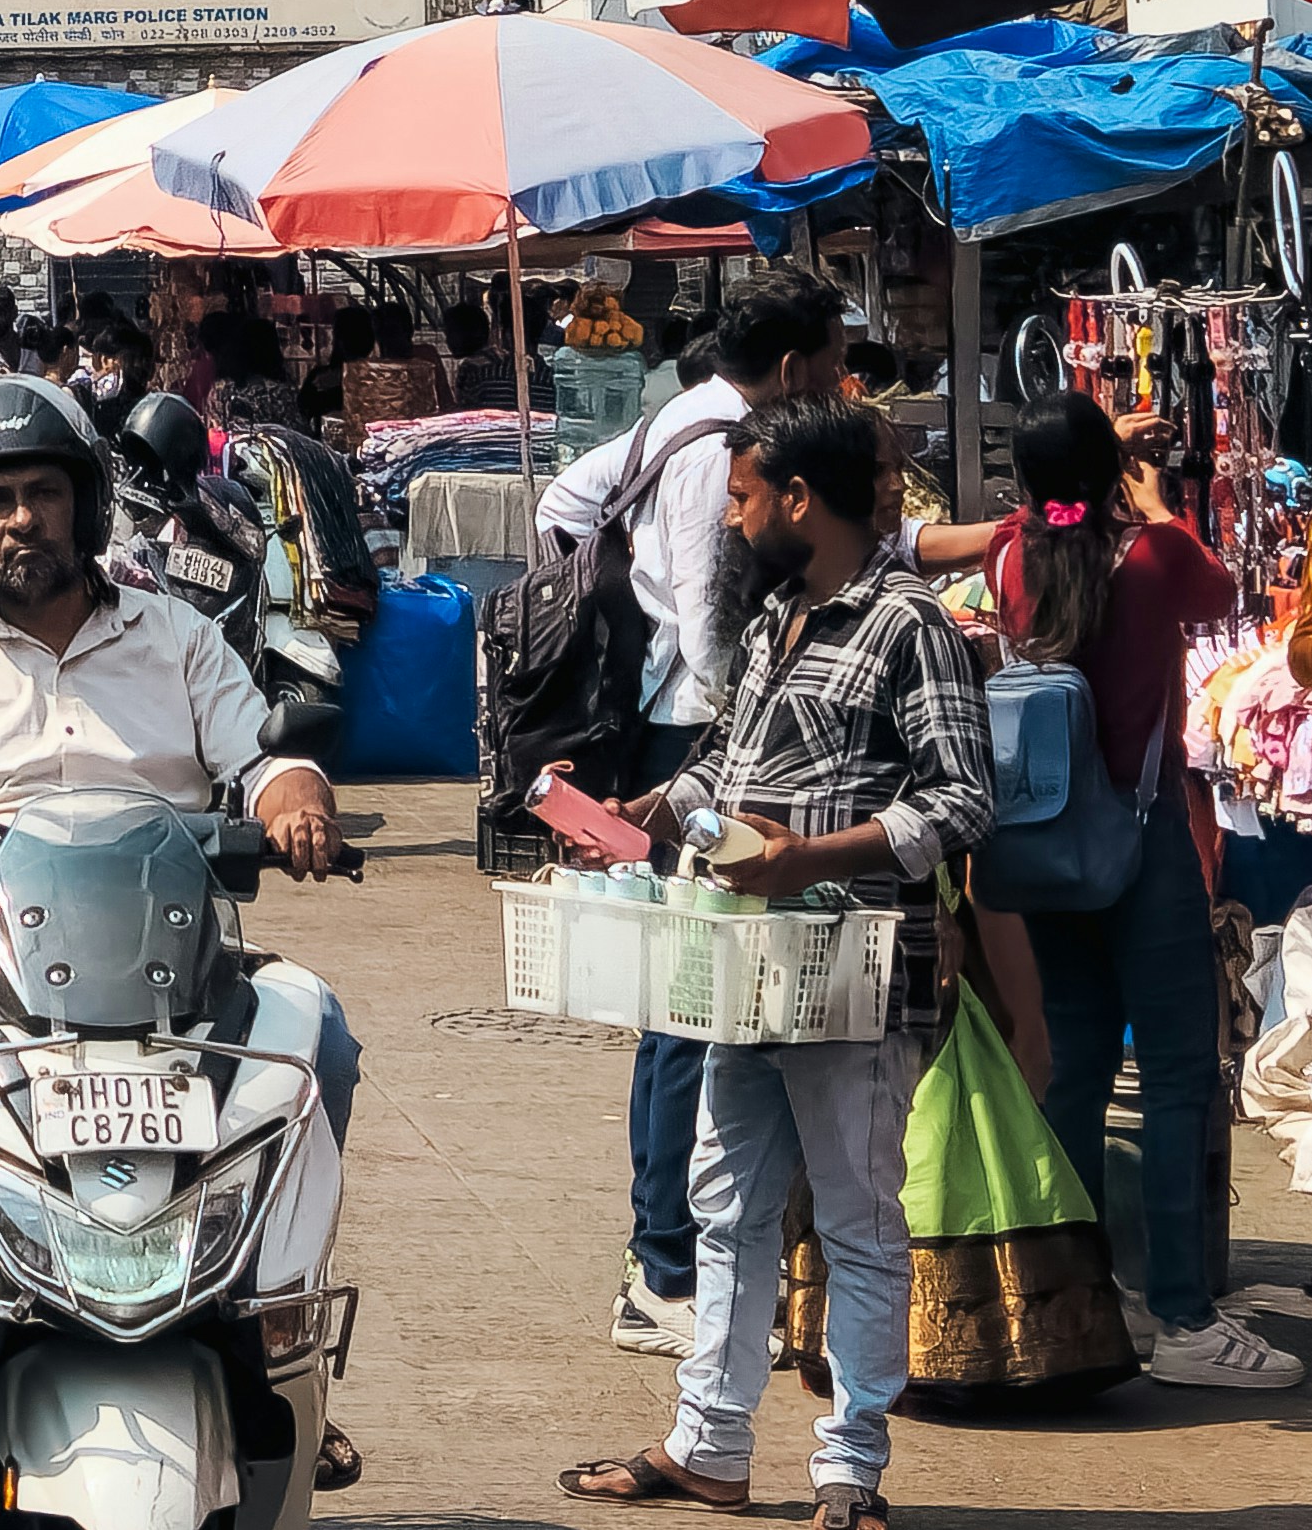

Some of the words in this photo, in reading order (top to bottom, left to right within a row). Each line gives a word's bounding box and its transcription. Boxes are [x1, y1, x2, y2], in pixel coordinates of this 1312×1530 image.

[9, 12, 62, 27] TILAK
[67, 10, 118, 25] MARG
[124, 9, 187, 23] POLICE
[193, 7, 268, 22] STATION
[65, 1078, 181, 1110] MH01E
[70, 1113, 184, 1146] C8760
